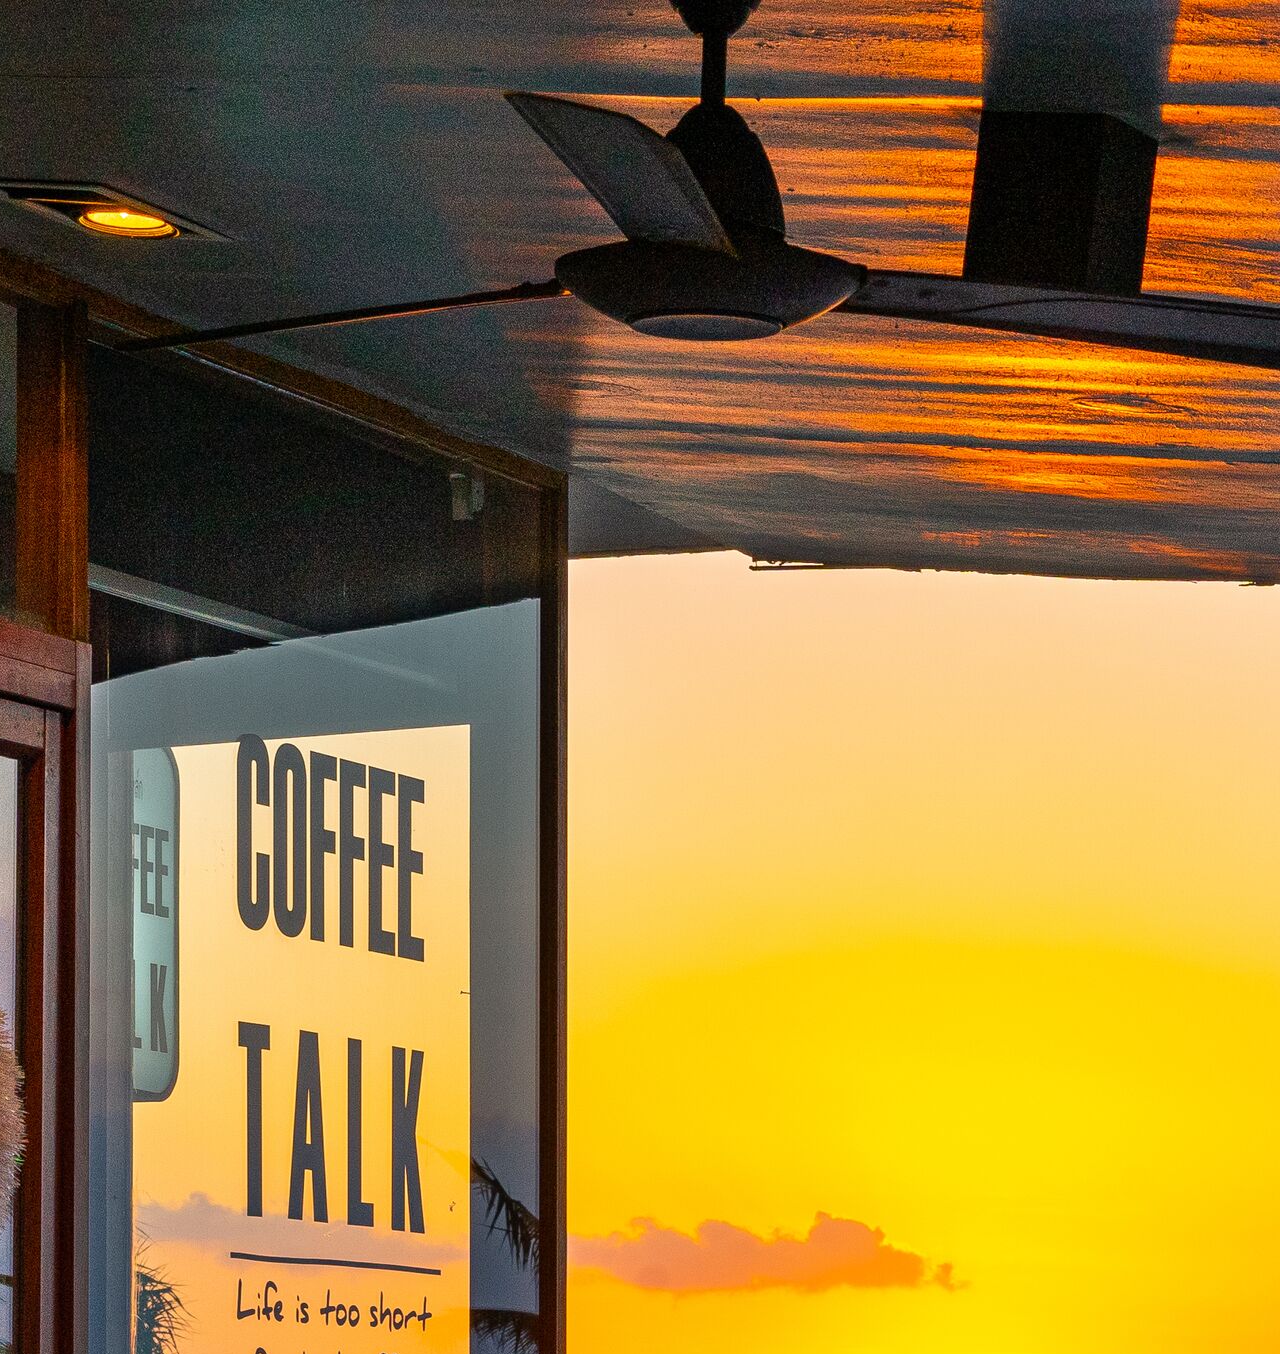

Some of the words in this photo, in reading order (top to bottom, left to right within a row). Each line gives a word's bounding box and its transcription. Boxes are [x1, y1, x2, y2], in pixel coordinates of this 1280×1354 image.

[237, 734, 425, 962] COFFEE
[238, 1021, 425, 1234] TALK
[237, 1279, 284, 1321] Life
[295, 1294, 309, 1325] is
[320, 1290, 360, 1328] too
[370, 1291, 432, 1331] short
